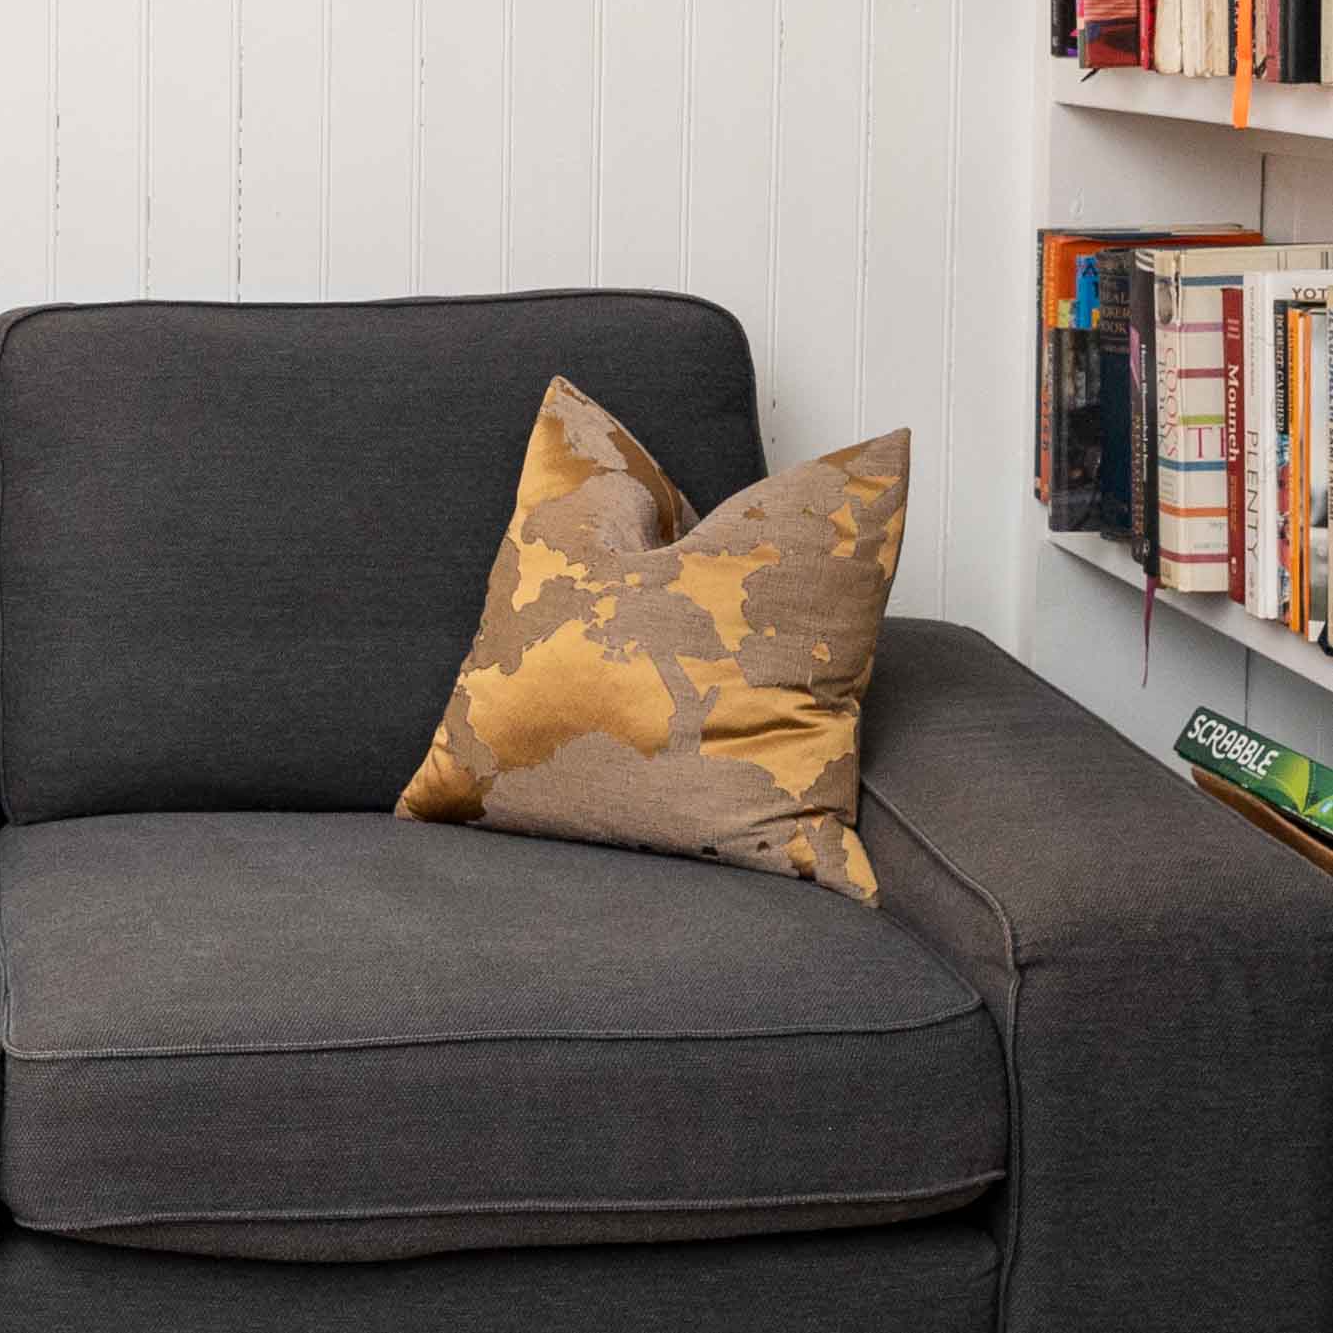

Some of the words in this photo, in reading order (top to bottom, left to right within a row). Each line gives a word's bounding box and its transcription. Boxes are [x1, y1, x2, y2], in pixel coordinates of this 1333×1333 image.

[1275, 314, 1285, 366] ROBERT
[1275, 370, 1285, 432] CARRIER
[1247, 430, 1259, 562] PLENTY
[1187, 714, 1280, 777] SCRABBLE
